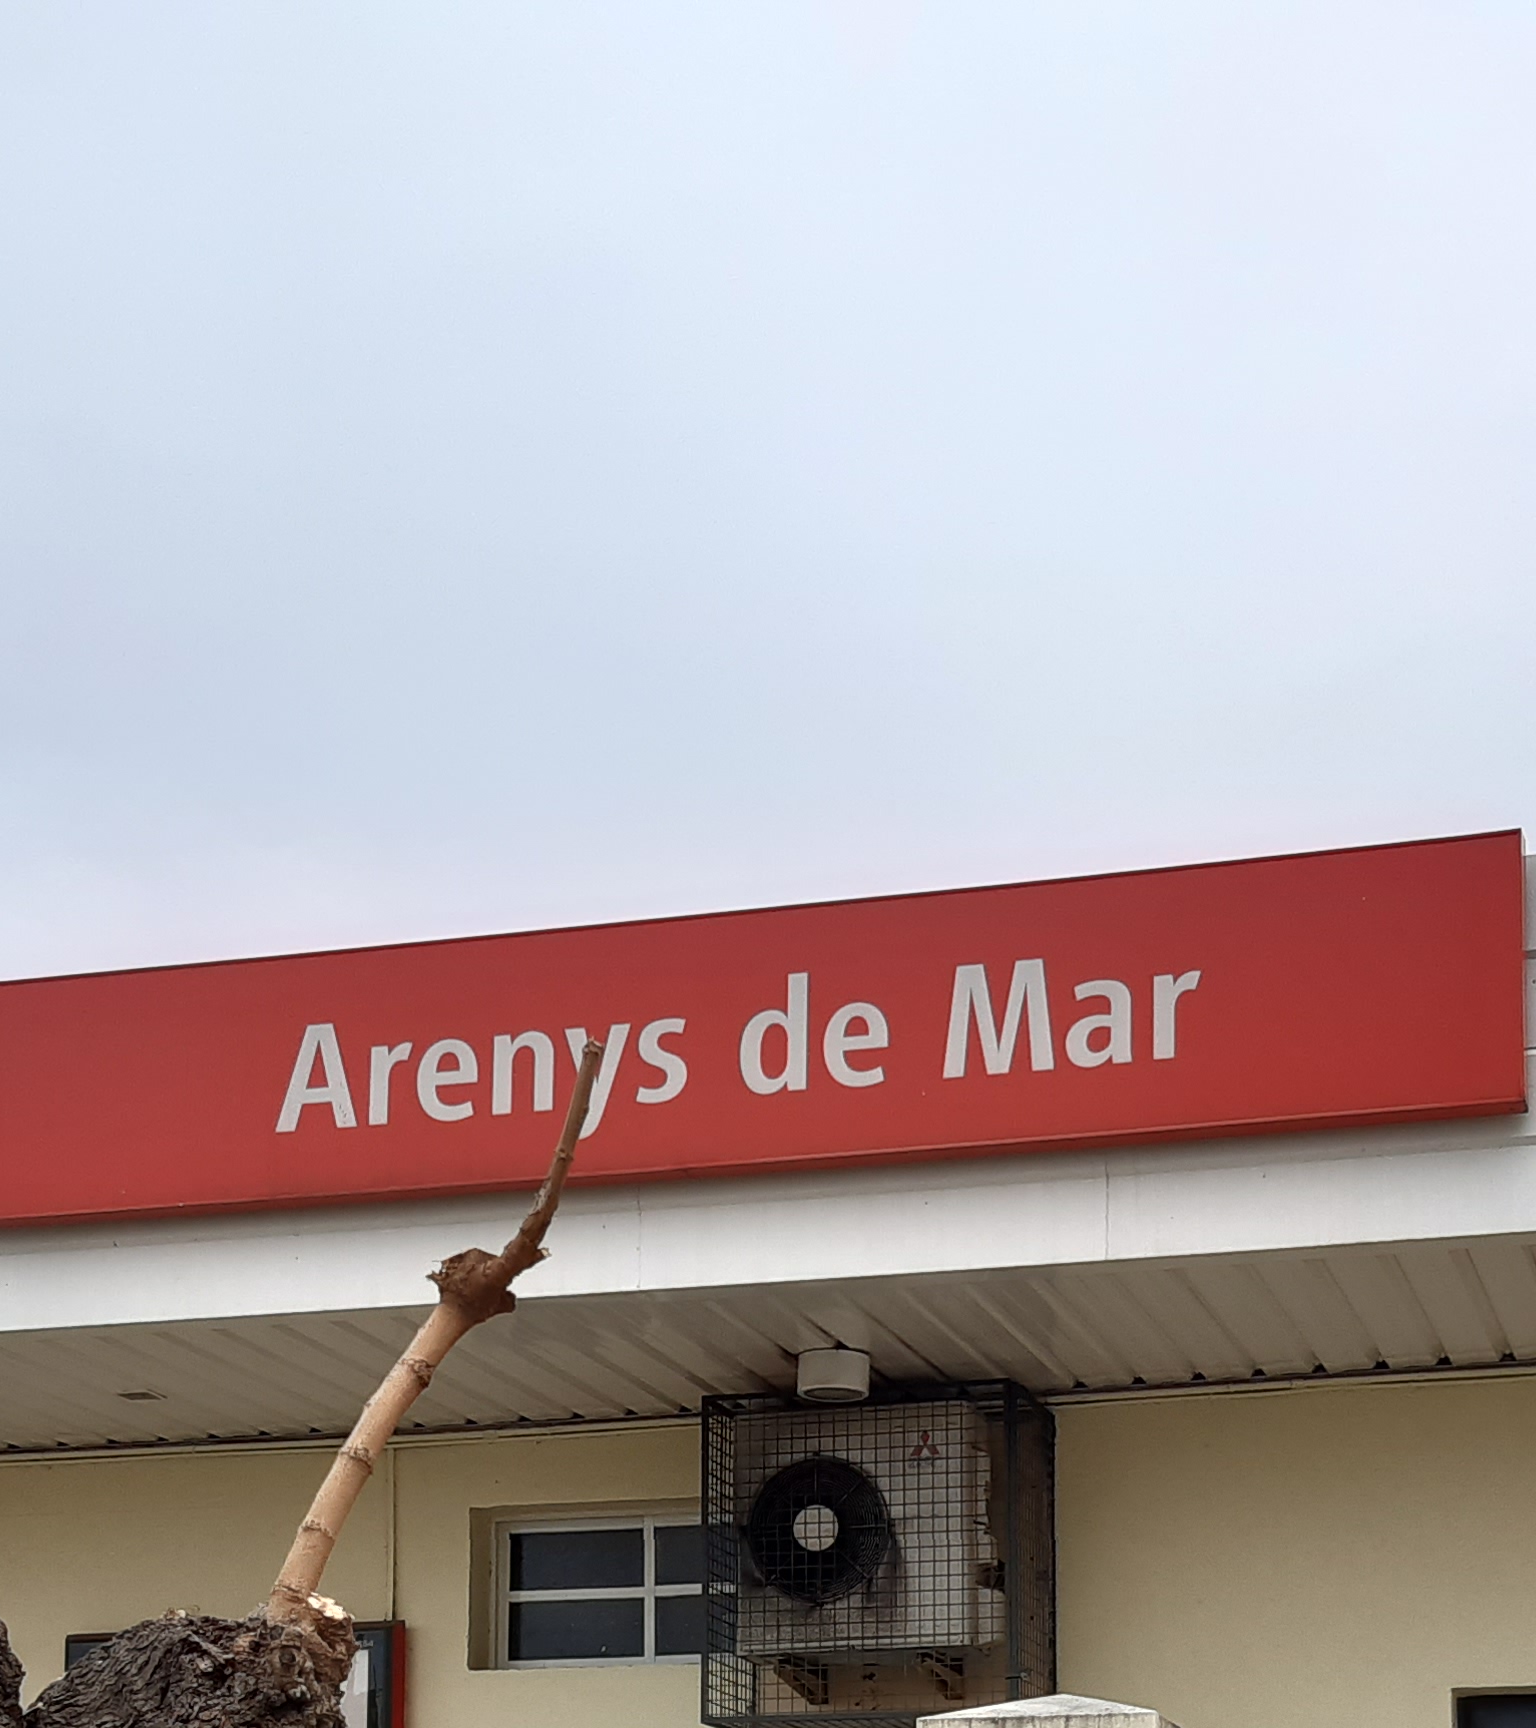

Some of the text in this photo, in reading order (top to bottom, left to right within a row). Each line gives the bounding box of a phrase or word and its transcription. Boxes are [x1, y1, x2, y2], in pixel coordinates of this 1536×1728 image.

[275, 958, 1202, 1141] Arenys de Mar
